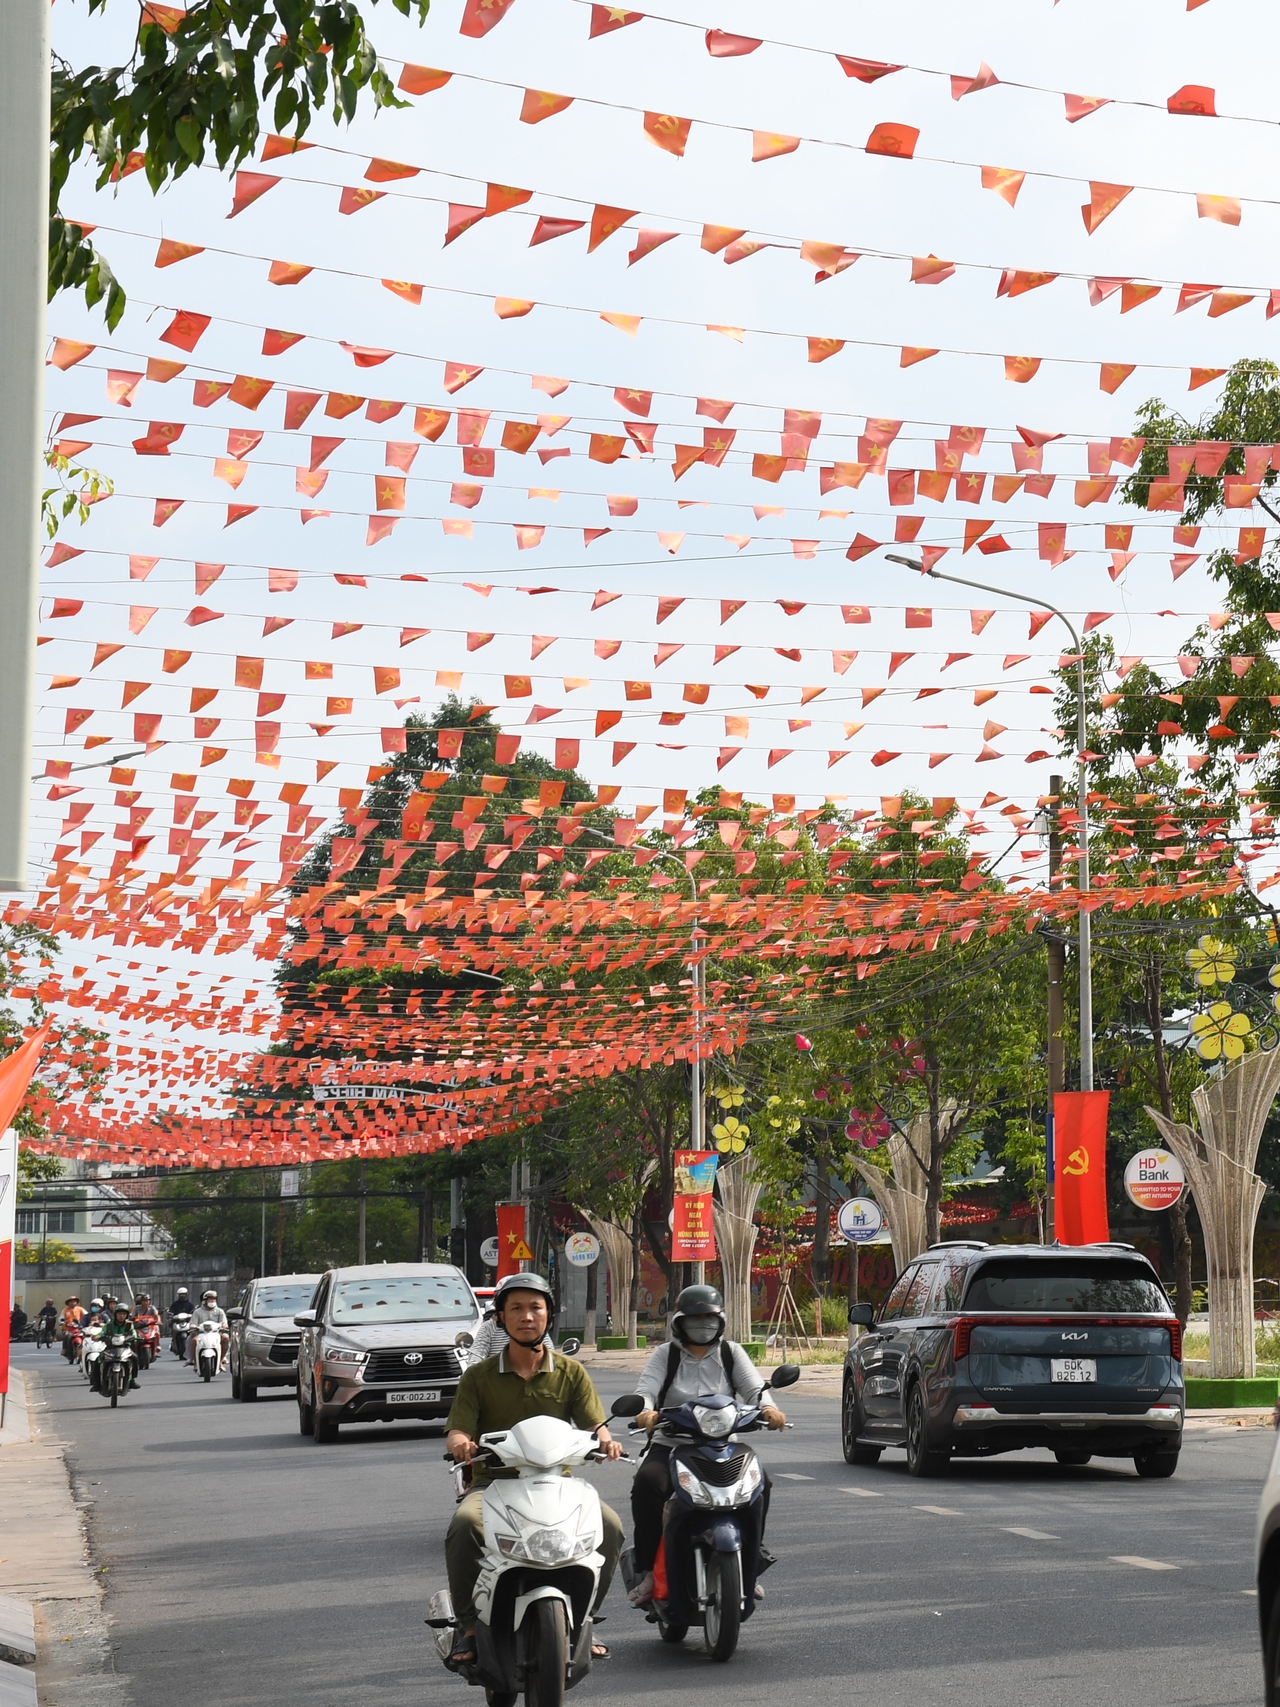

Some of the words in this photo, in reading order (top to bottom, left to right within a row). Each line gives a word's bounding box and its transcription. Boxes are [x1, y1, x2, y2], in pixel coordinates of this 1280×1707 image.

[1139, 1158, 1157, 1169] HD
[1139, 1169, 1169, 1180] Bank
[1064, 1360, 1083, 1370] 60K
[1056, 1371, 1091, 1381] 826.12
[390, 1392, 437, 1402] 60K-002.23
